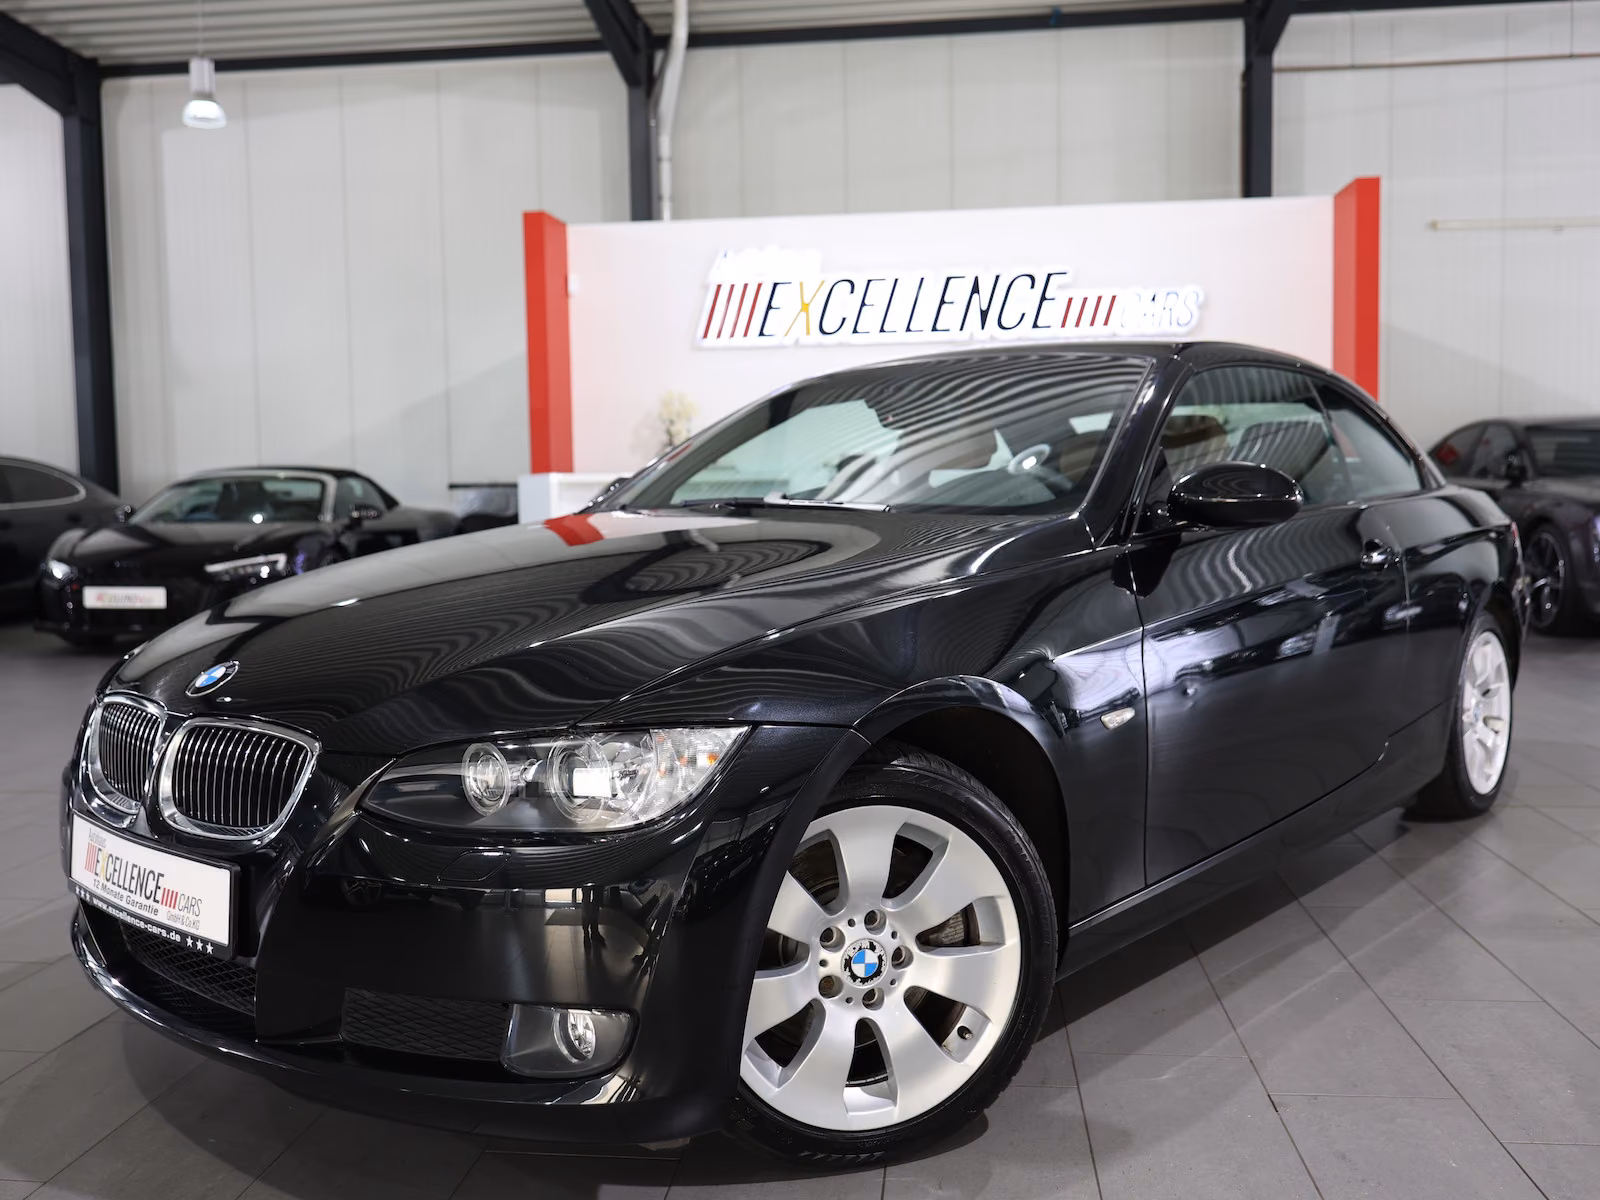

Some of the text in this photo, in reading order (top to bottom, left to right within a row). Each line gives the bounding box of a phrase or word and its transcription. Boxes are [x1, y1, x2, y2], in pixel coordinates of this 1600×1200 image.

[758, 271, 1068, 337] EXCELLENCE
[94, 848, 203, 917] EXCELLENCE CARS
[101, 882, 124, 902] Monate
[125, 893, 159, 916] Garantie
[92, 896, 181, 943] www.excellence-cars.de
